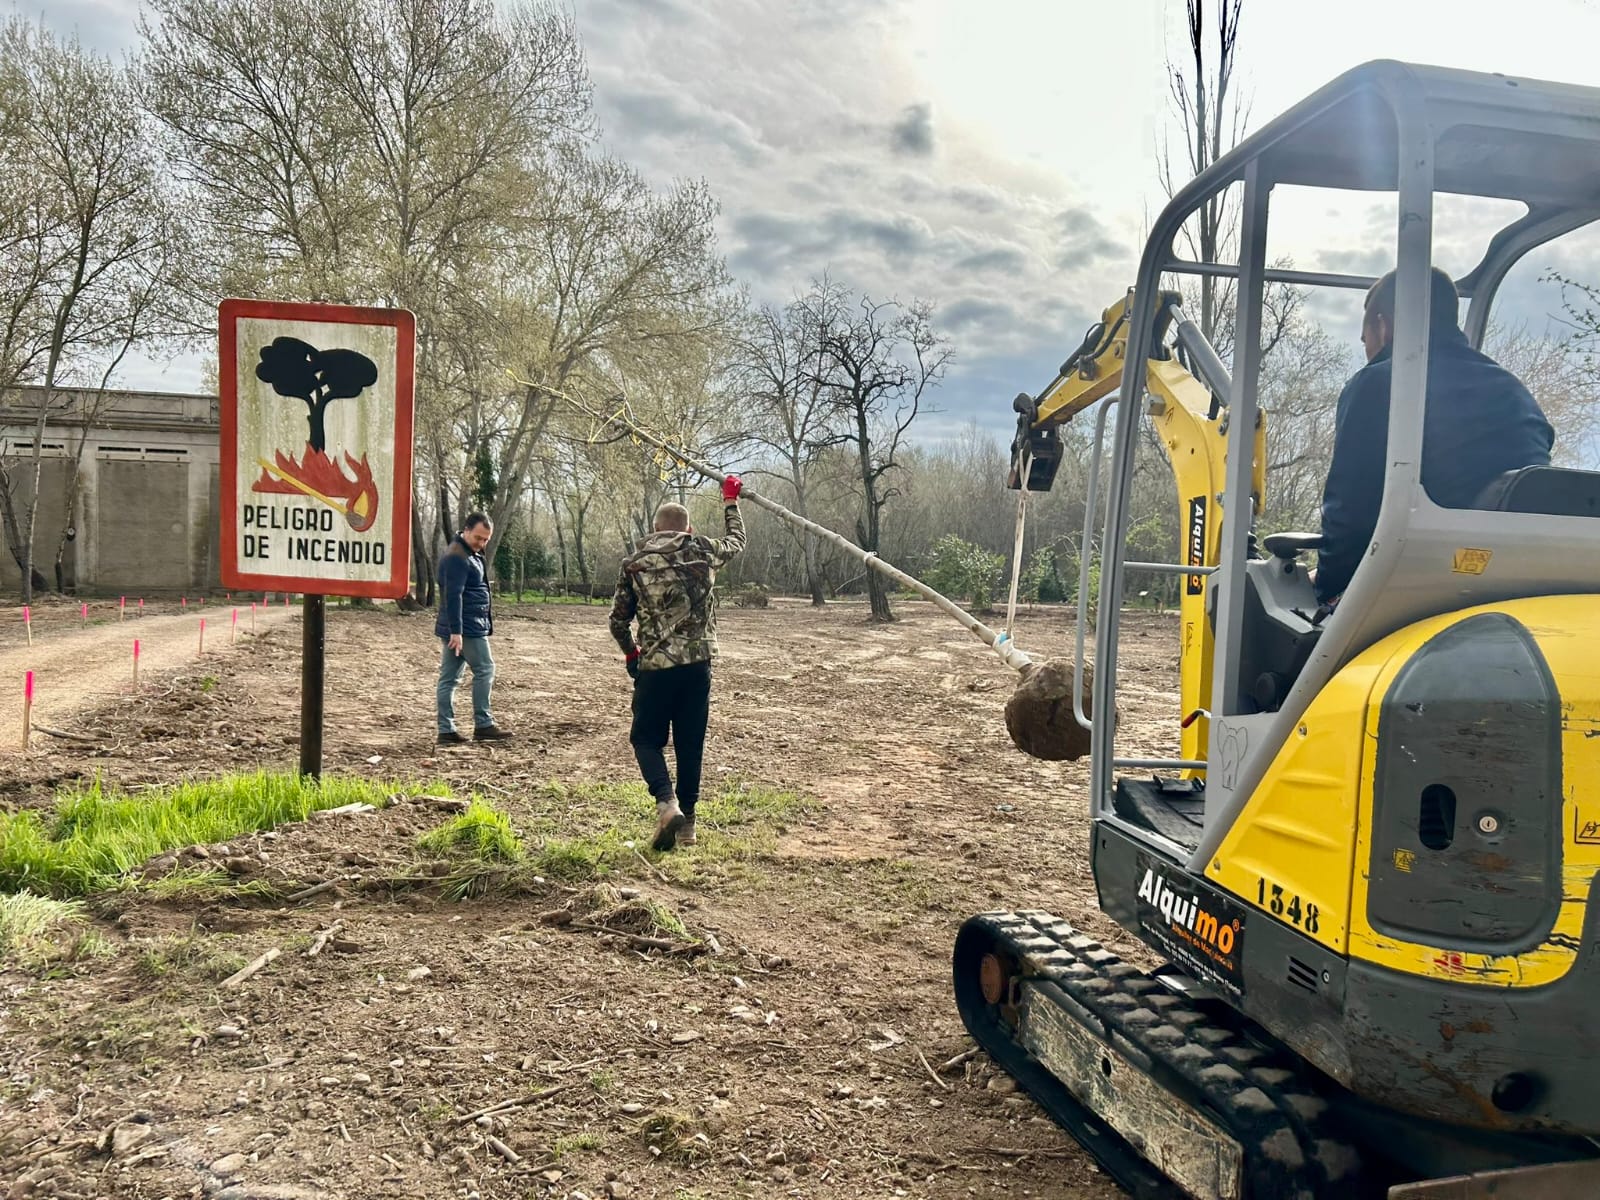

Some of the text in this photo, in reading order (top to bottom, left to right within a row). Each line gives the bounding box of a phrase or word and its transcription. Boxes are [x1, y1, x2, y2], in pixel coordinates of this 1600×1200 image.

[243, 504, 333, 532] PELIGRO
[244, 534, 385, 565] DE INCENDIO
[1257, 877, 1320, 934] 1348
